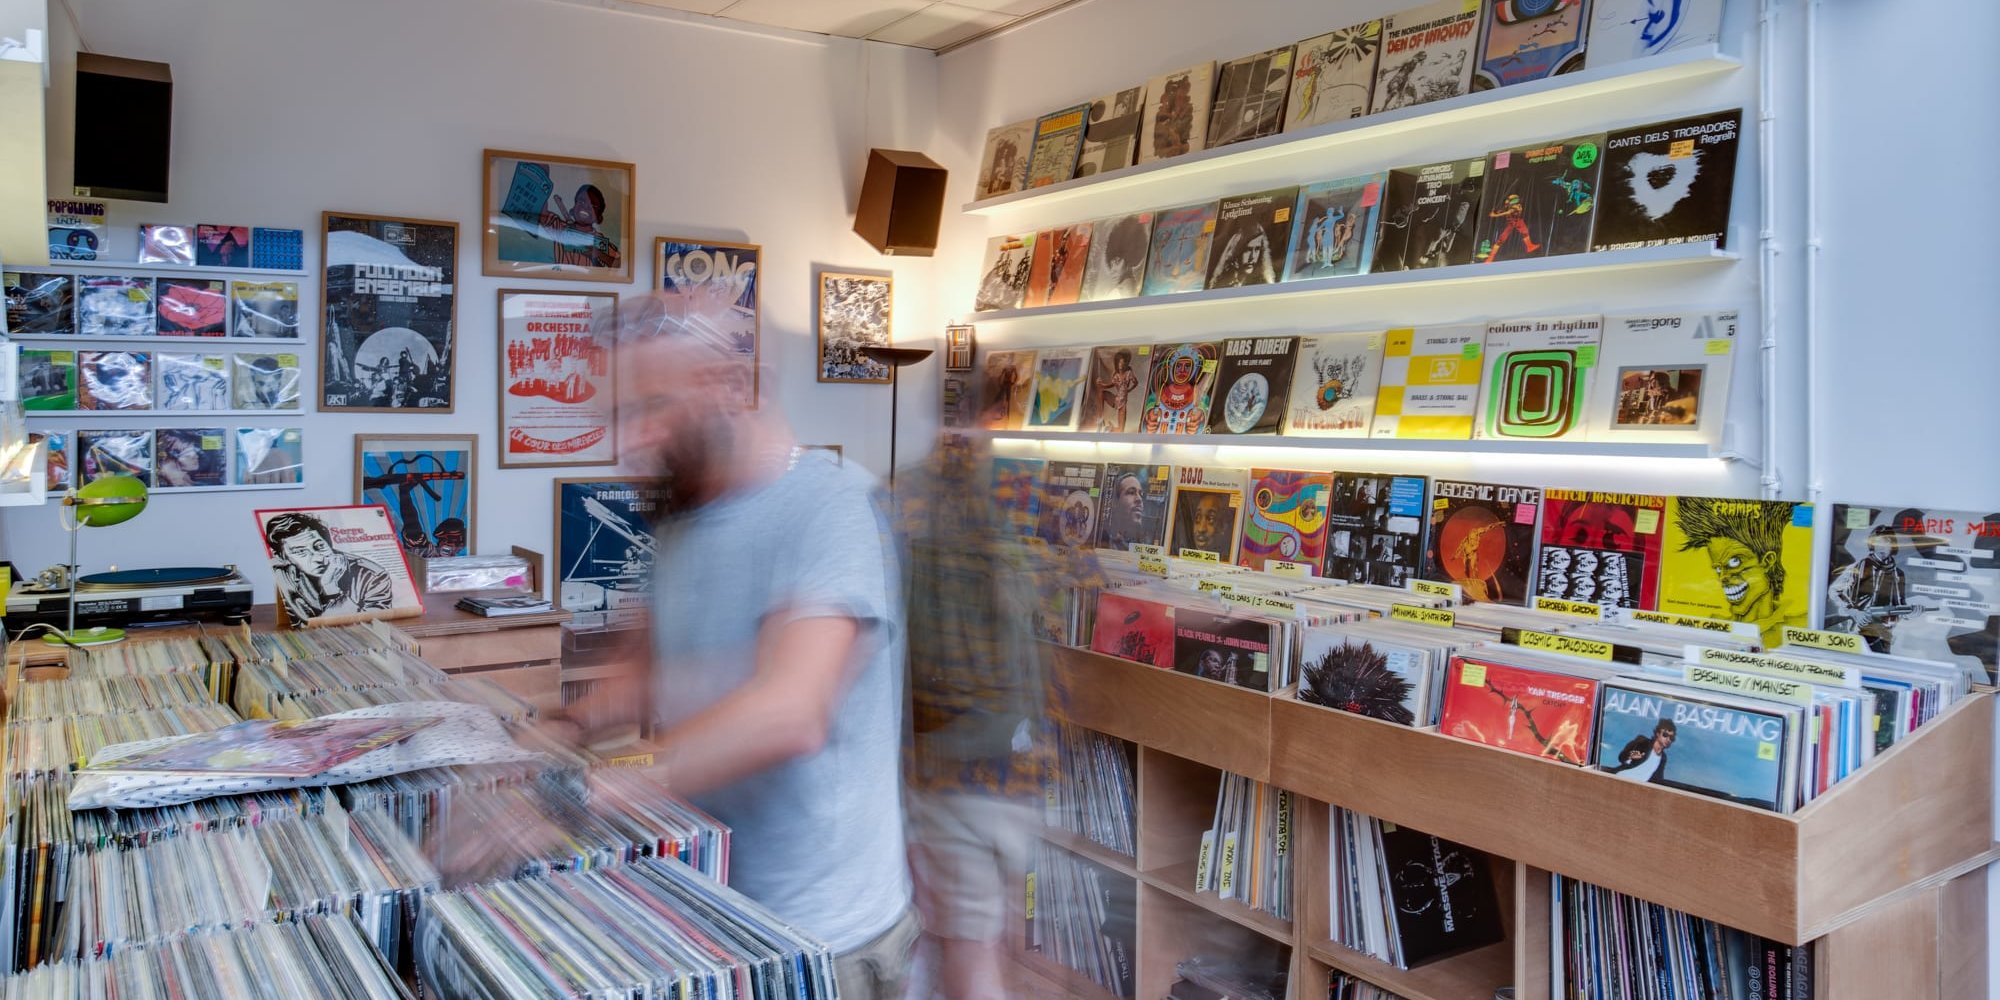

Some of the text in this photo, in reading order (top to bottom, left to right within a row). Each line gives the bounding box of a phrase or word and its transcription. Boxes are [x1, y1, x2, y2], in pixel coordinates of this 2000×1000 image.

[1389, 10, 1477, 39] THE NORMAN HAINES BAND
[1387, 19, 1475, 55] DEN OF INIQUITY
[1608, 120, 1737, 150] CANTS DELS TROBADORS:
[1426, 181, 1442, 190] TRIO
[1429, 188, 1437, 196] IN
[1418, 195, 1448, 205] CONCERT
[527, 321, 592, 333] ORCHESTRA
[1489, 319, 1599, 334] colours in rhythm
[1651, 317, 1682, 330] gong
[1727, 324, 1736, 336] 5
[1226, 340, 1253, 356] BABS
[1254, 338, 1293, 355] ROBERT
[1181, 467, 1203, 484] ROJO
[596, 490, 640, 502] FRANÇOIS
[1499, 487, 1539, 505] DANCE
[1605, 491, 1665, 508] SUICIDES
[1713, 501, 1762, 519] CRAMPS
[330, 527, 365, 538] Serge
[1903, 516, 1955, 535] PARIS
[1416, 582, 1432, 592] FREE
[1571, 603, 1599, 616] GROOVE
[1440, 614, 1453, 623] POP
[1702, 620, 1732, 633] GARDE
[1239, 639, 1269, 652] COLTRANE
[1523, 632, 1552, 648] COSMIC
[1786, 629, 1856, 648] FRENCH SONG
[1692, 668, 1740, 688] BASHUNG
[1751, 678, 1800, 696] MANSET
[1604, 691, 1781, 742] ALAIN BASHUNG
[1278, 811, 1288, 834] BLUES
[1438, 875, 1455, 932] MASSIVE
[1767, 950, 1778, 998] THE ROLLING
